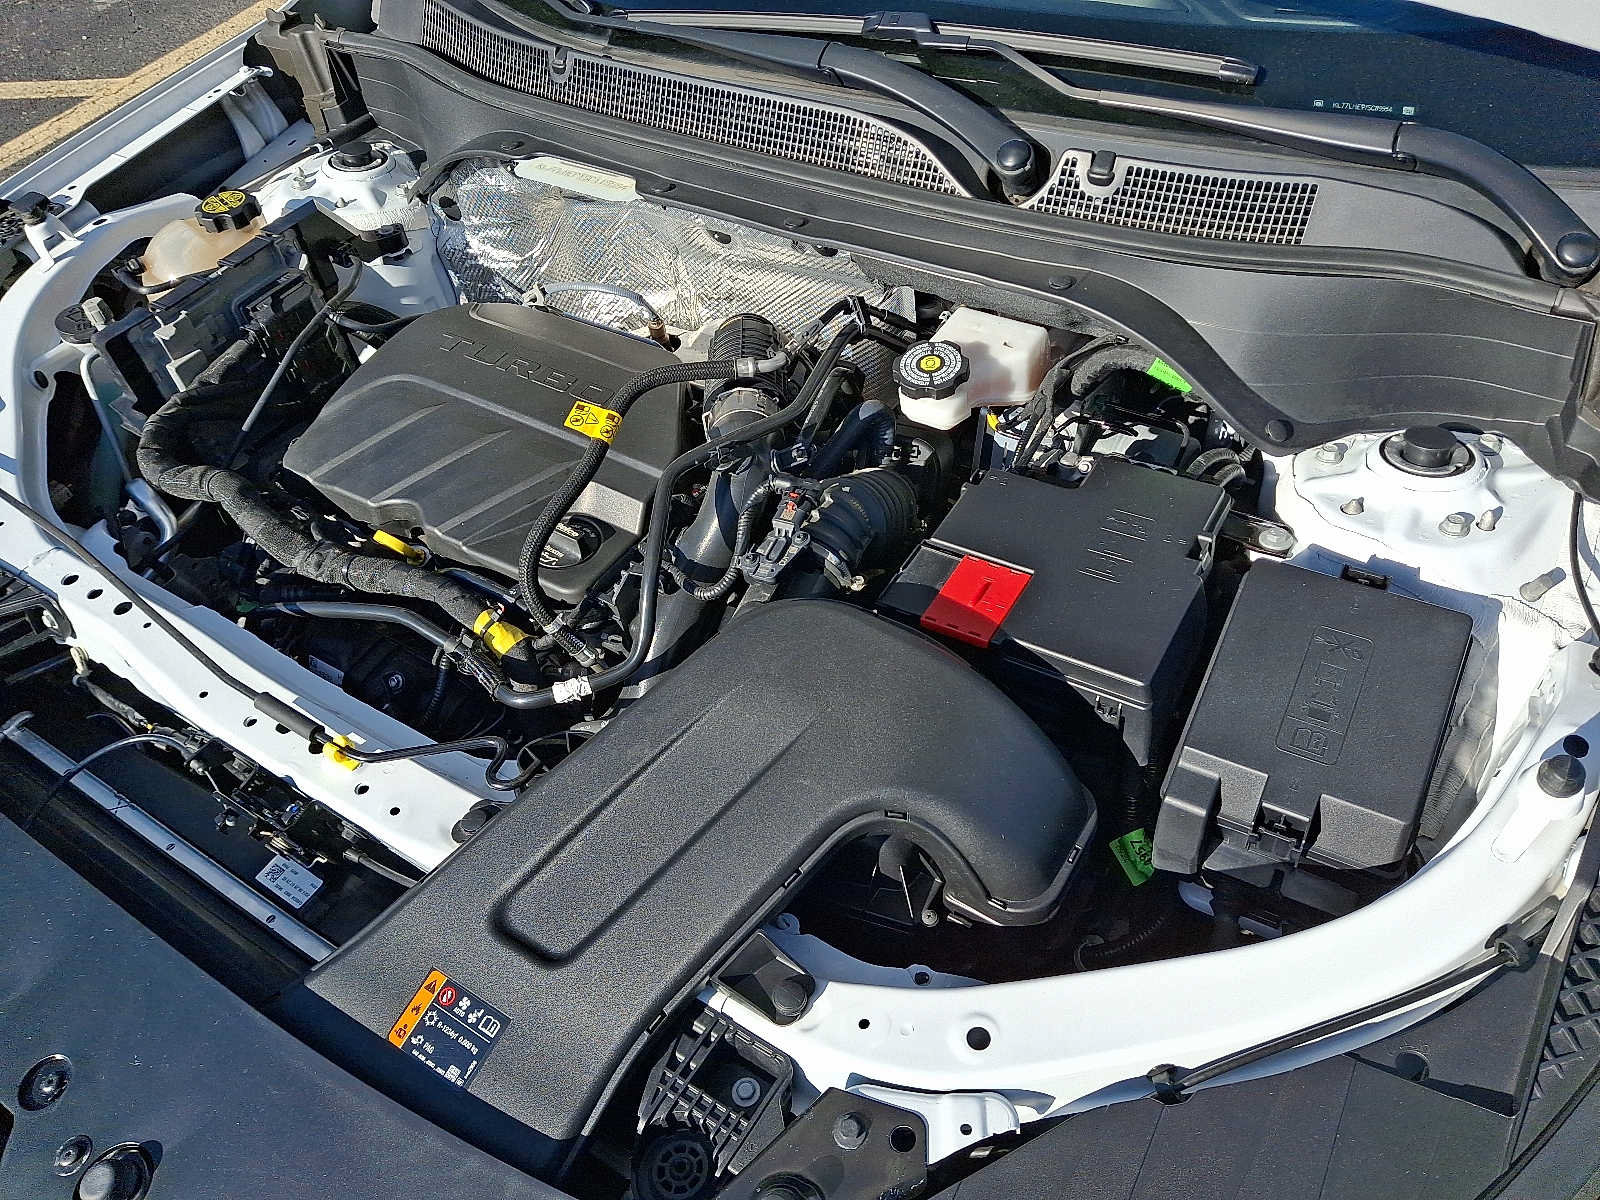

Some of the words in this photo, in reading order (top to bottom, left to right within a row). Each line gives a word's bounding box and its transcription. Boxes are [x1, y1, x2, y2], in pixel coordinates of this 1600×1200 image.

[439, 332, 615, 406] TURBO
[453, 1006, 466, 1018] AUTO
[436, 1021, 459, 1040] R-1234yf
[422, 1042, 435, 1055] PAG
